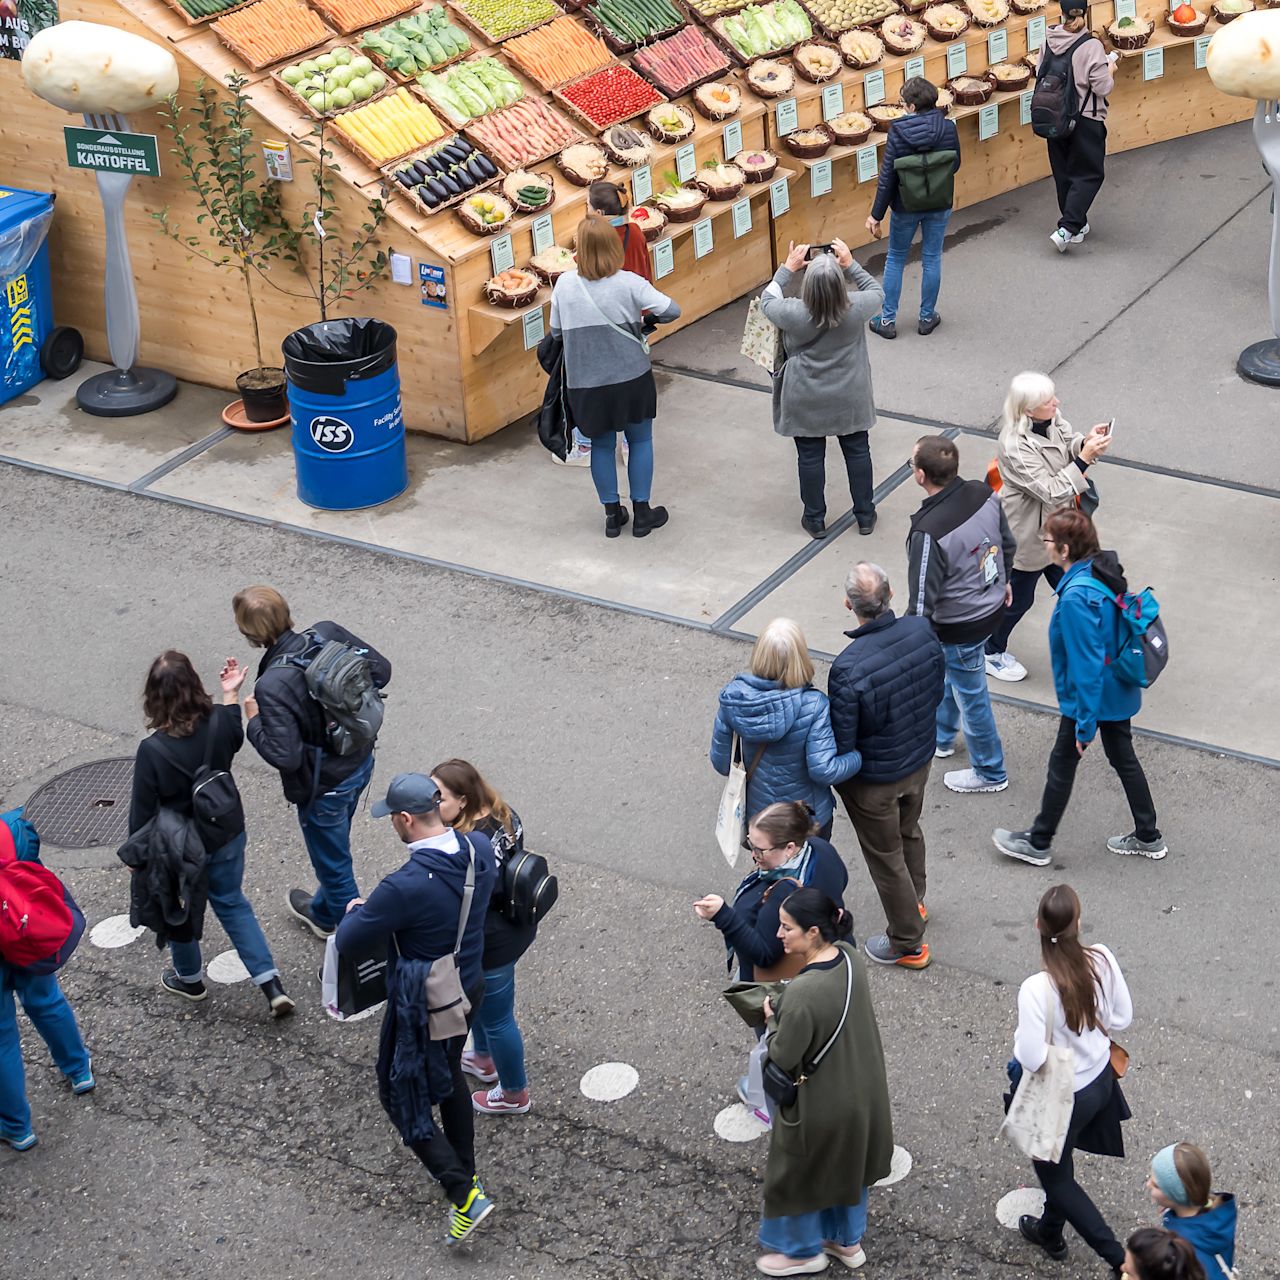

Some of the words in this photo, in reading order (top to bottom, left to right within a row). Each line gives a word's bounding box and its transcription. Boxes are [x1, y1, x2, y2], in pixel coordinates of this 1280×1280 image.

[5, 16, 29, 32] AUS
[76, 142, 145, 157] SONDERAUSSTELLUNG
[77, 151, 150, 172] KARTOFFEL
